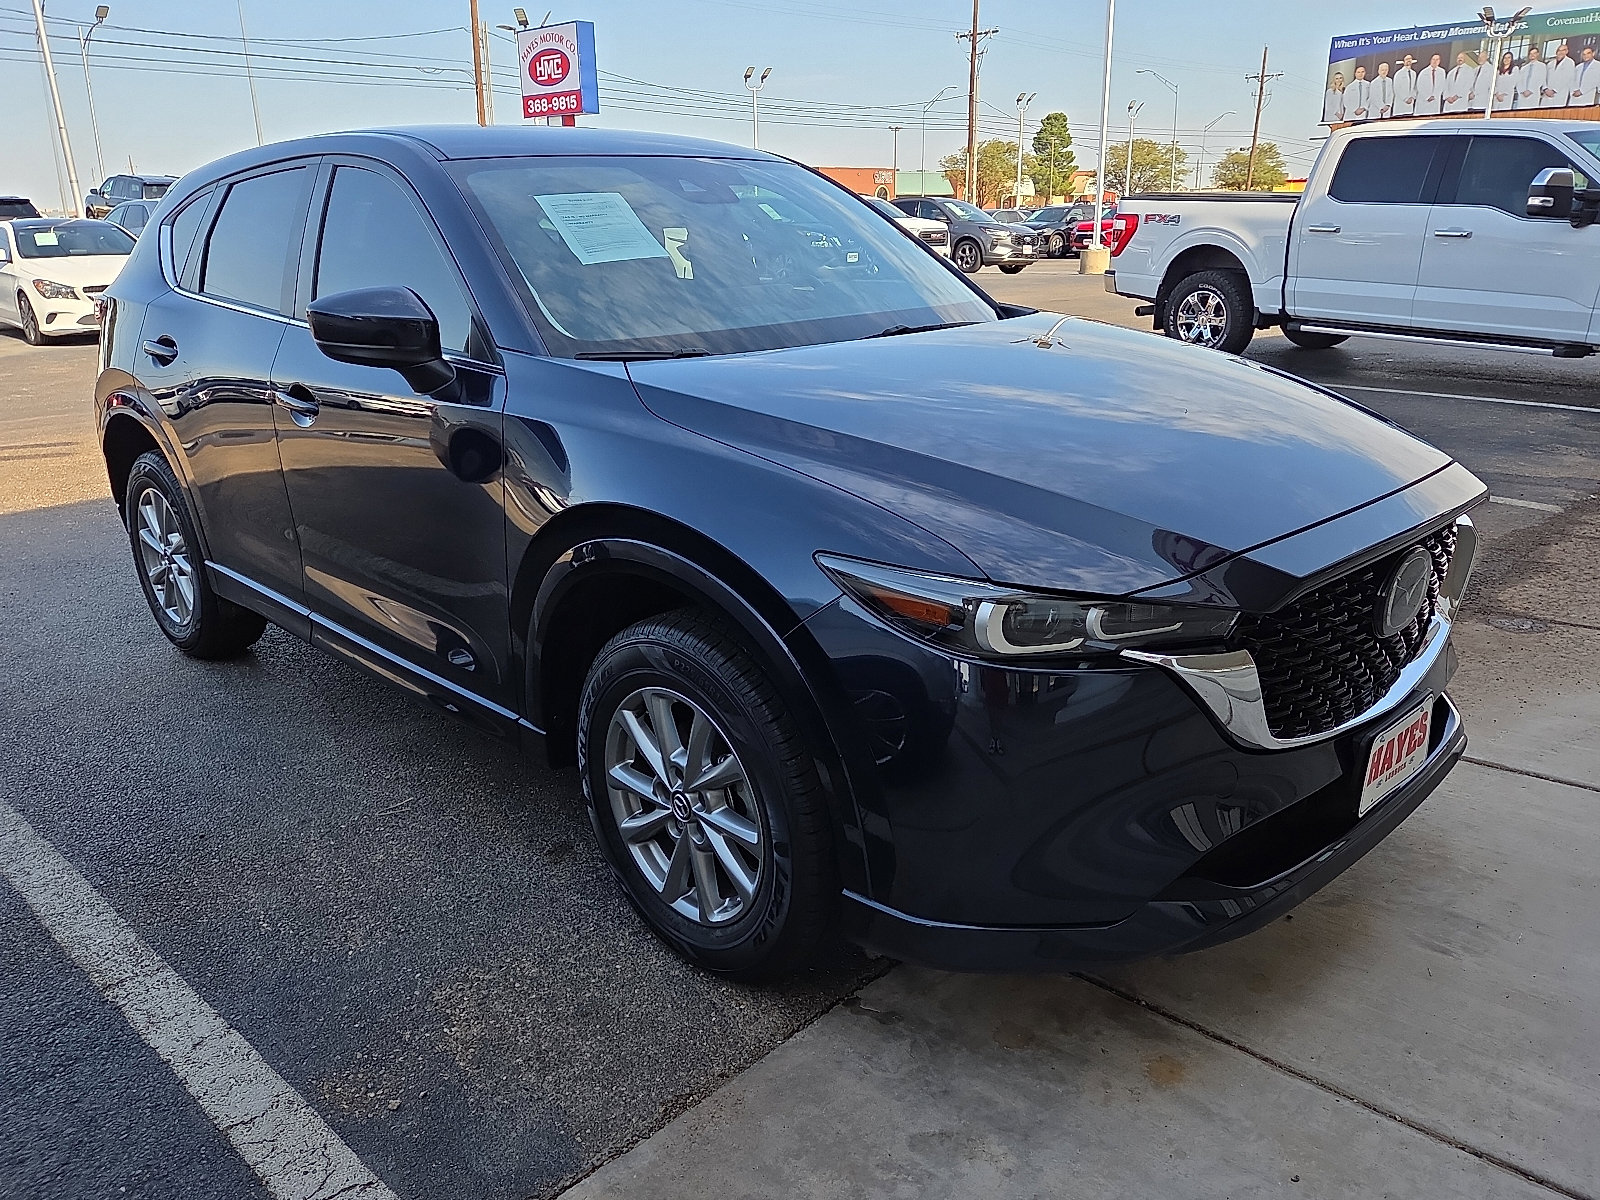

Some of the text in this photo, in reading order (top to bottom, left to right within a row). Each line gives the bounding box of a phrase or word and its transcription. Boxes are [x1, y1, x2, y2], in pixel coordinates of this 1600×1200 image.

[521, 32, 576, 62] HAYES MOTOR CO.
[1334, 39, 1357, 49] When
[1359, 37, 1370, 46] It's
[1372, 36, 1392, 45] Your
[1393, 33, 1419, 43] Heart,
[1420, 30, 1448, 40] Every
[527, 95, 577, 113] 368-9815
[1143, 214, 1181, 224] FX4
[1198, 283, 1226, 300] COOPER
[1366, 711, 1428, 788] HAYES
